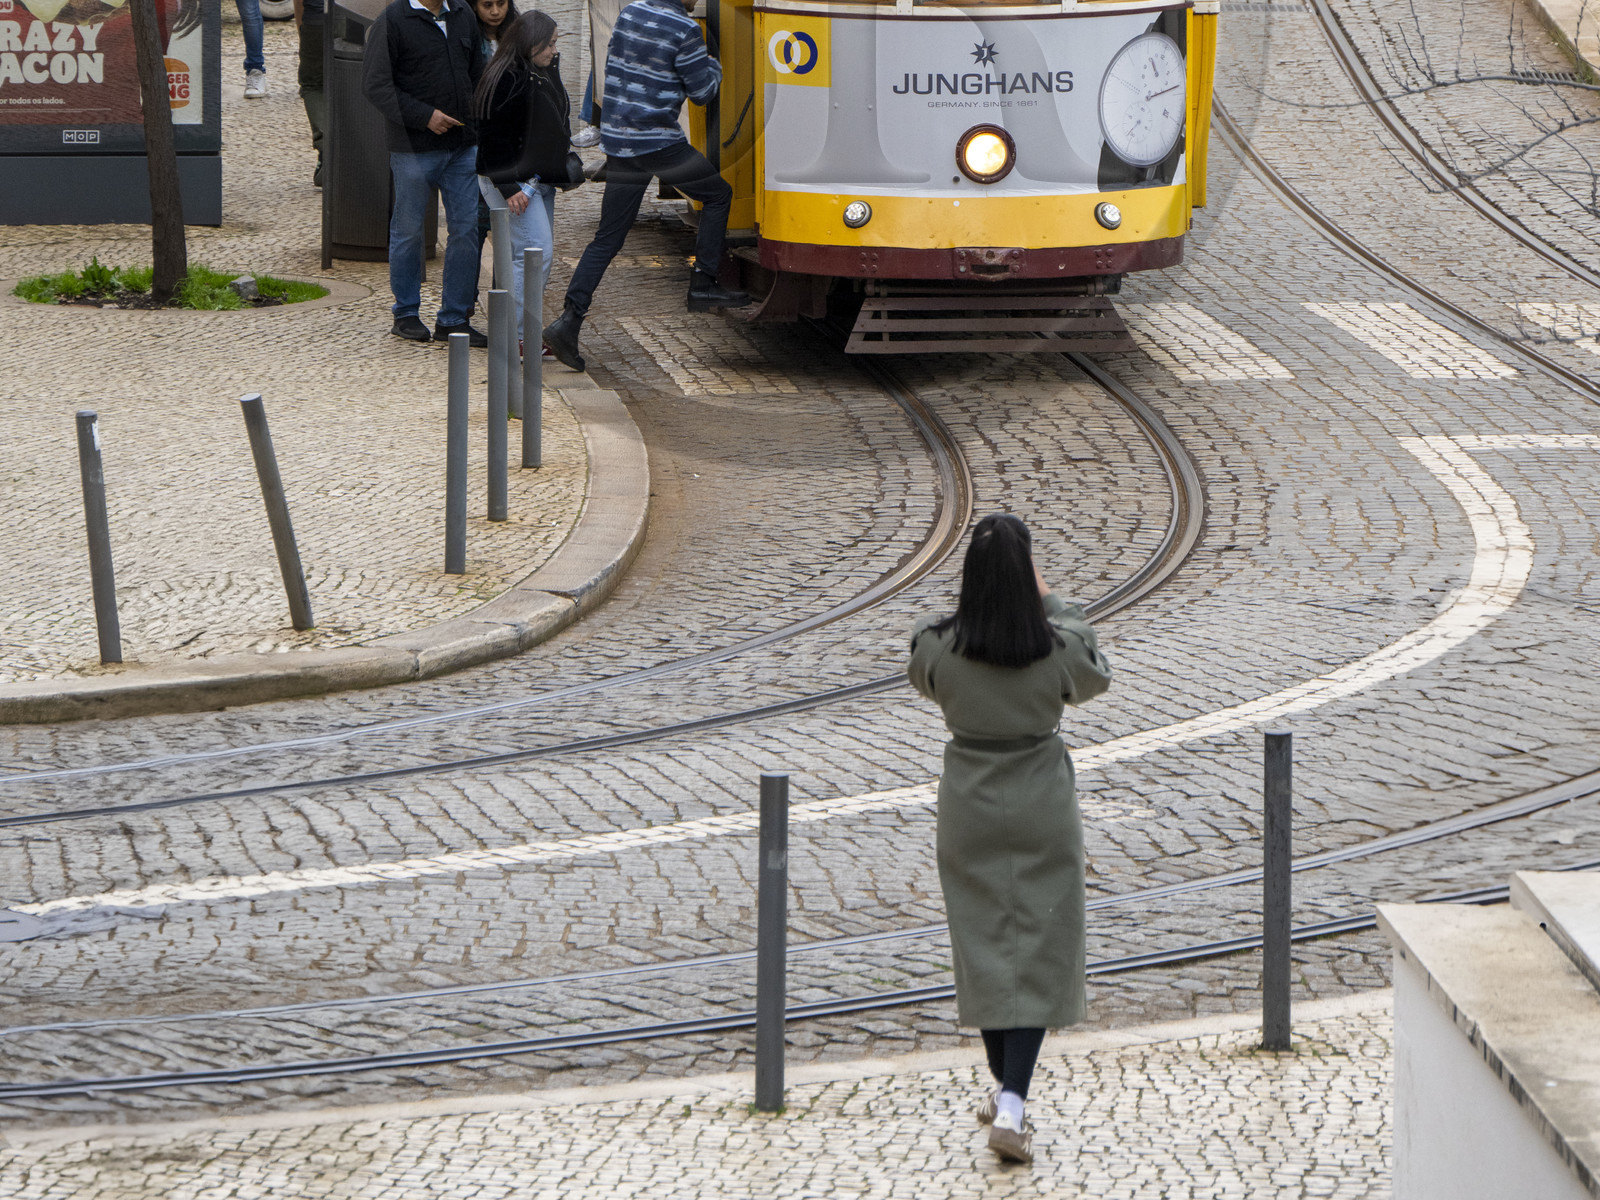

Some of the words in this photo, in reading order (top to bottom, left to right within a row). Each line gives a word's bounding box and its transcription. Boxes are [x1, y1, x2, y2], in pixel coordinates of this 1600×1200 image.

[168, 74, 190, 84] GER
[892, 70, 1074, 95] JUNGHANS
[169, 84, 190, 99] NG
[65, 133, 97, 141] MOP
